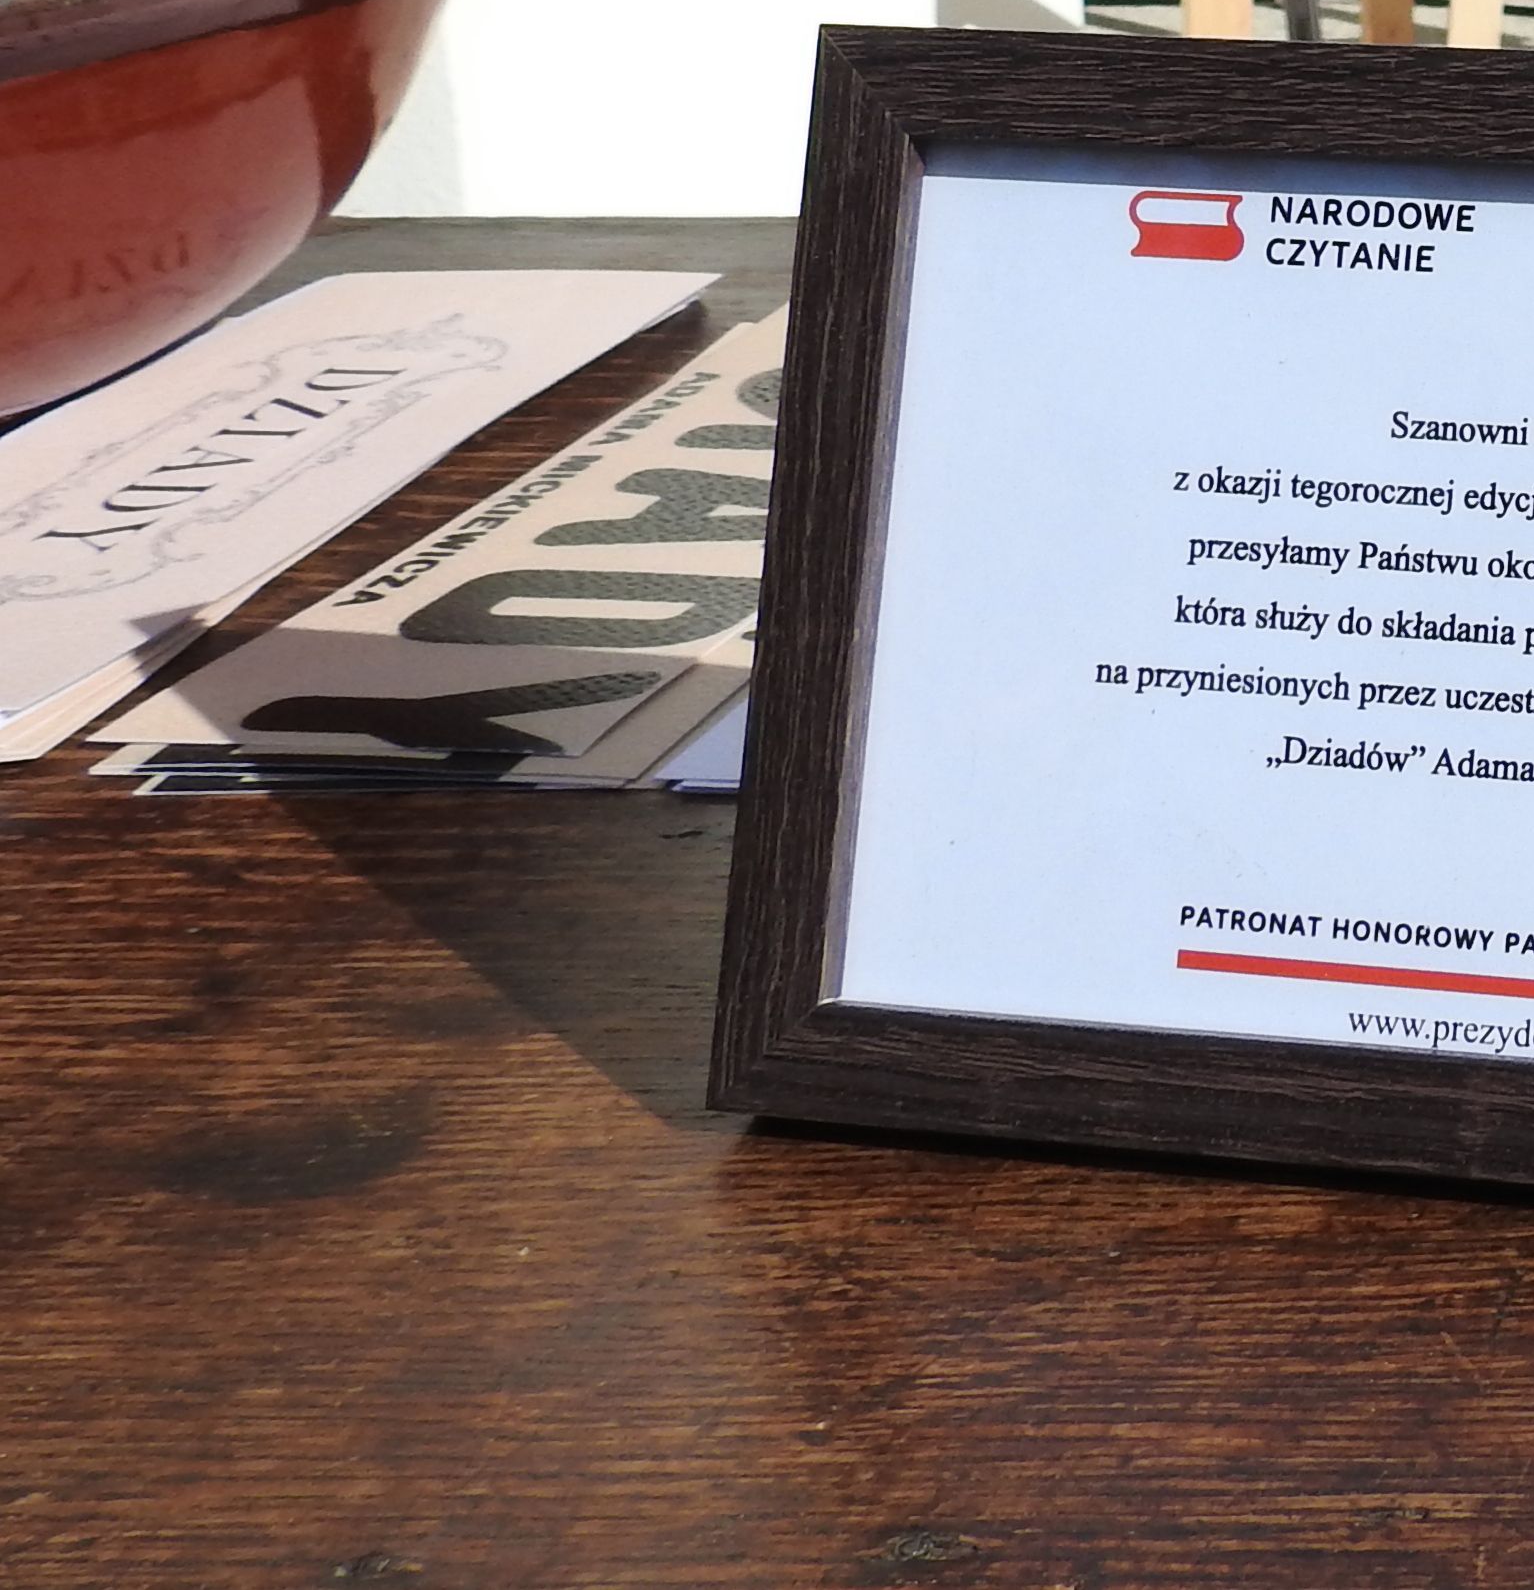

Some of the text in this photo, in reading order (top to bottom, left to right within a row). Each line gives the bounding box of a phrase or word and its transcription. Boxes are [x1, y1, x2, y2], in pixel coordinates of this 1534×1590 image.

[1271, 197, 1475, 232] NARODOWE
[1266, 238, 1435, 272] CZYTANIE
[1391, 411, 1528, 445] Szanowni
[33, 366, 408, 551] DZIADY
[333, 371, 721, 607] ADAMA MICKIEWICZA
[1173, 472, 1190, 491] z
[1198, 466, 1281, 504] okazji
[1291, 474, 1454, 515] tegorocznej
[1187, 536, 1350, 574] przesyłamy
[1358, 542, 1478, 576] Państwu
[1174, 595, 1246, 627] która
[1255, 601, 1330, 640] służy
[1338, 606, 1372, 636] do
[1382, 610, 1516, 645] składania
[1095, 664, 1129, 684] na
[1135, 663, 1350, 705] przyniesionych
[1357, 683, 1437, 710] przez
[1266, 736, 1426, 772] „Dziadów”
[1180, 906, 1322, 937] PATRONAT
[1333, 918, 1494, 951] HONOROWY
